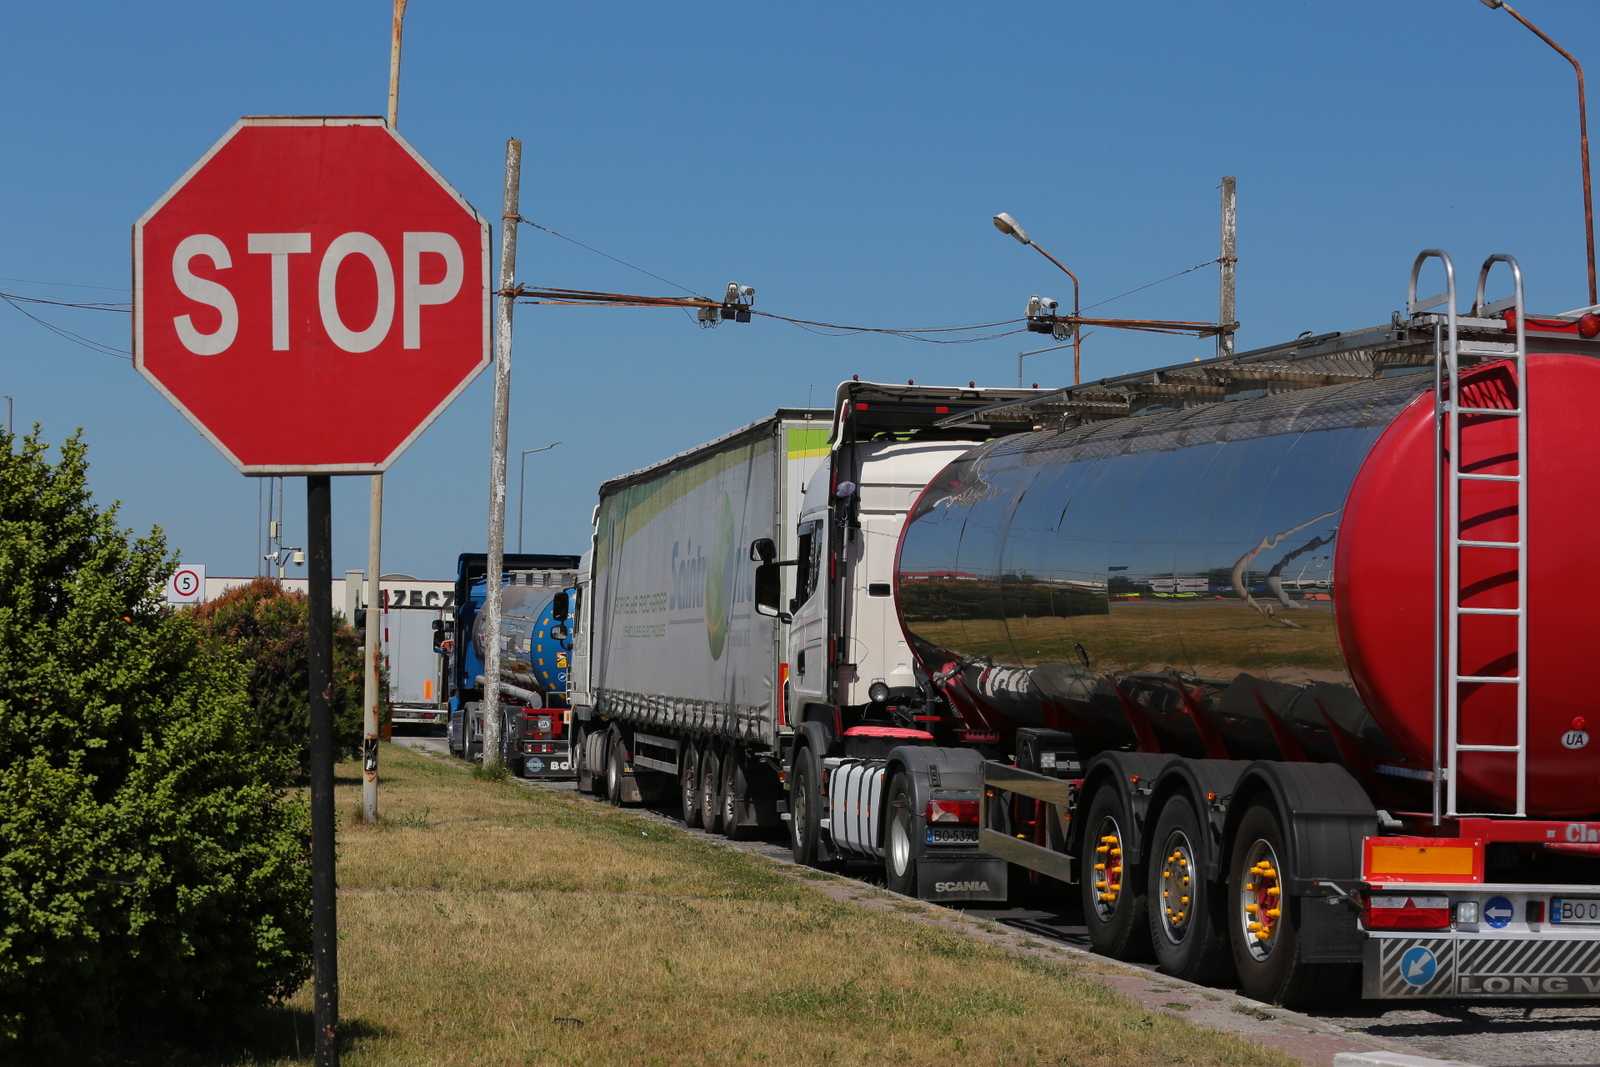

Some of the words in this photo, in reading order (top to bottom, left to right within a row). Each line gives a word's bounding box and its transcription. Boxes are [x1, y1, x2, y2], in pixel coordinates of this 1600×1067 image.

[171, 230, 466, 356] STOP
[182, 576, 191, 591] 5
[1564, 733, 1585, 747] UA
[934, 830, 949, 842] BO
[935, 880, 990, 893] SCANIA
[1562, 903, 1586, 919] BO
[1460, 976, 1569, 994] LONG
